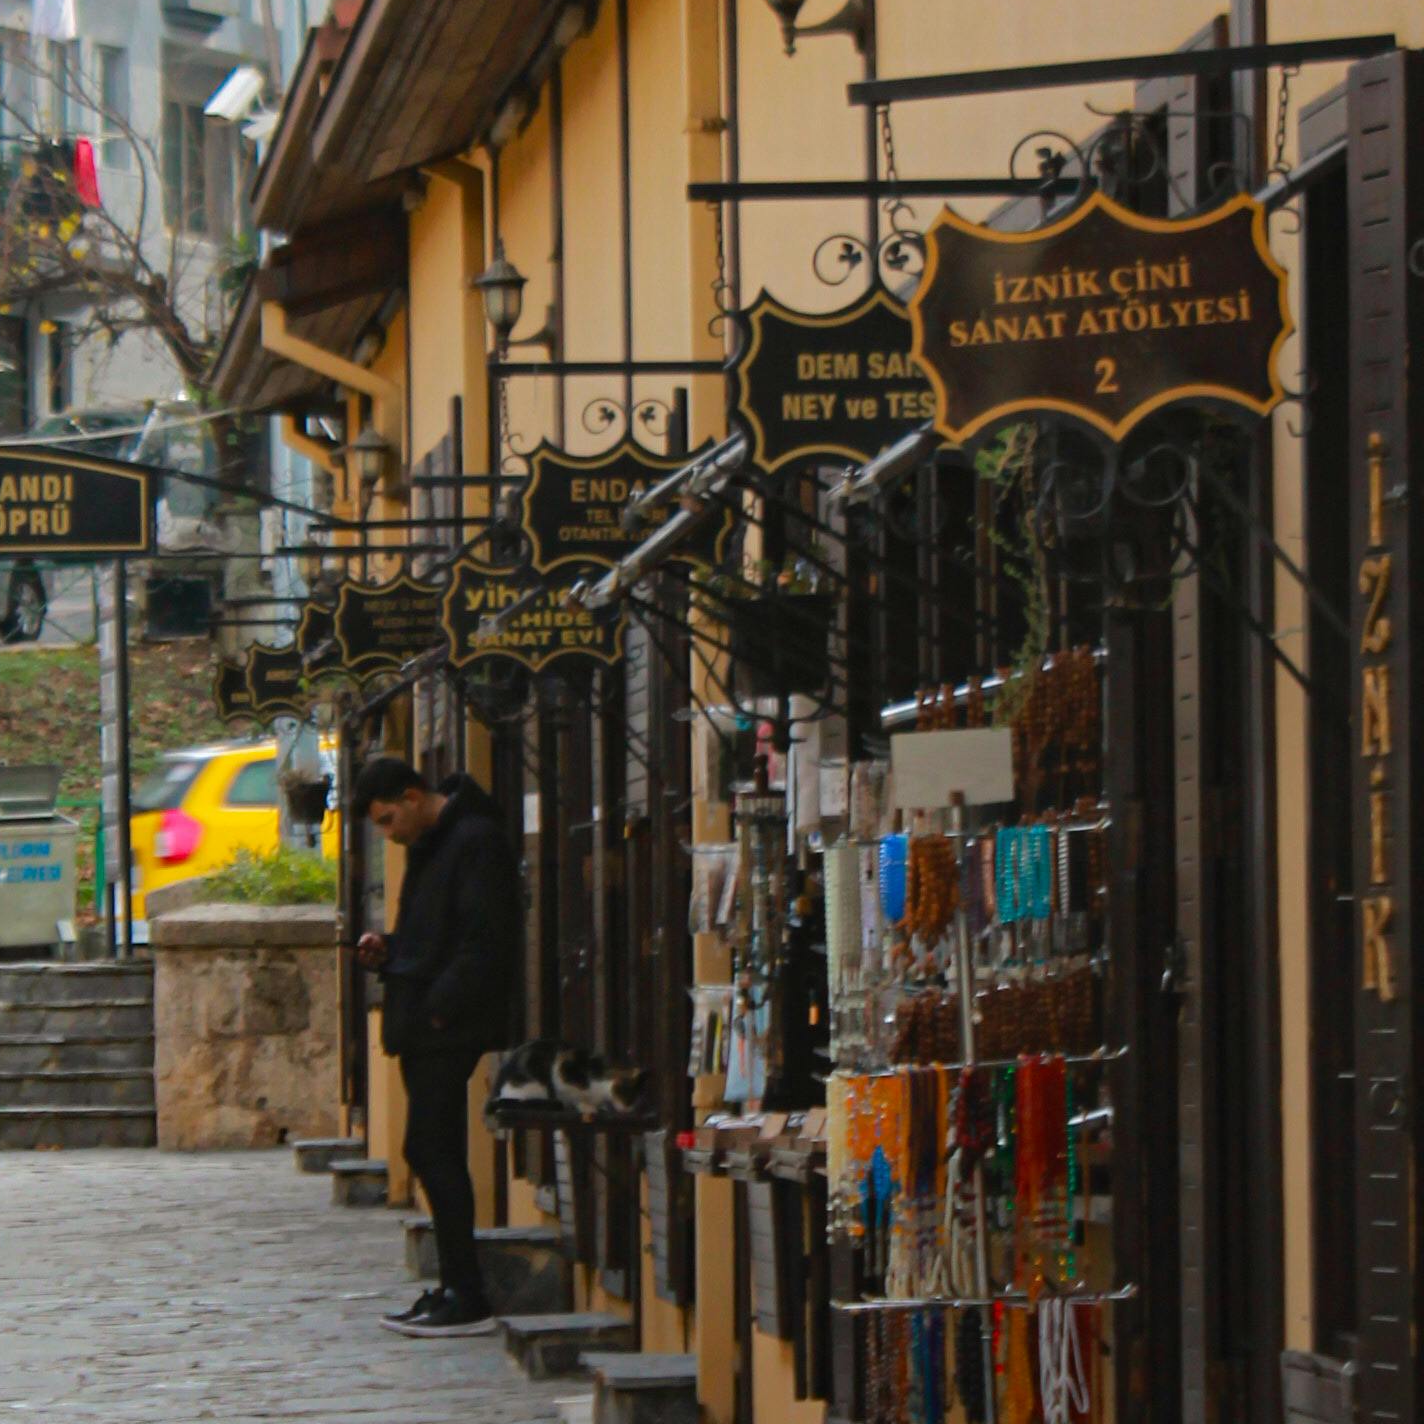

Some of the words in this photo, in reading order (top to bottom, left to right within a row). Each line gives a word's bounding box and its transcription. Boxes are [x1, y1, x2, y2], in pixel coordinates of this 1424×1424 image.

[994, 260, 1097, 306] İZNİK
[1108, 256, 1192, 296] ÇİNİ
[949, 313, 1067, 348] SANAT
[1077, 294, 1253, 338] ATÖLYESİ
[797, 353, 859, 380] DEM
[1094, 358, 1119, 394] 2
[782, 392, 837, 421] NEY
[844, 398, 878, 420] ve
